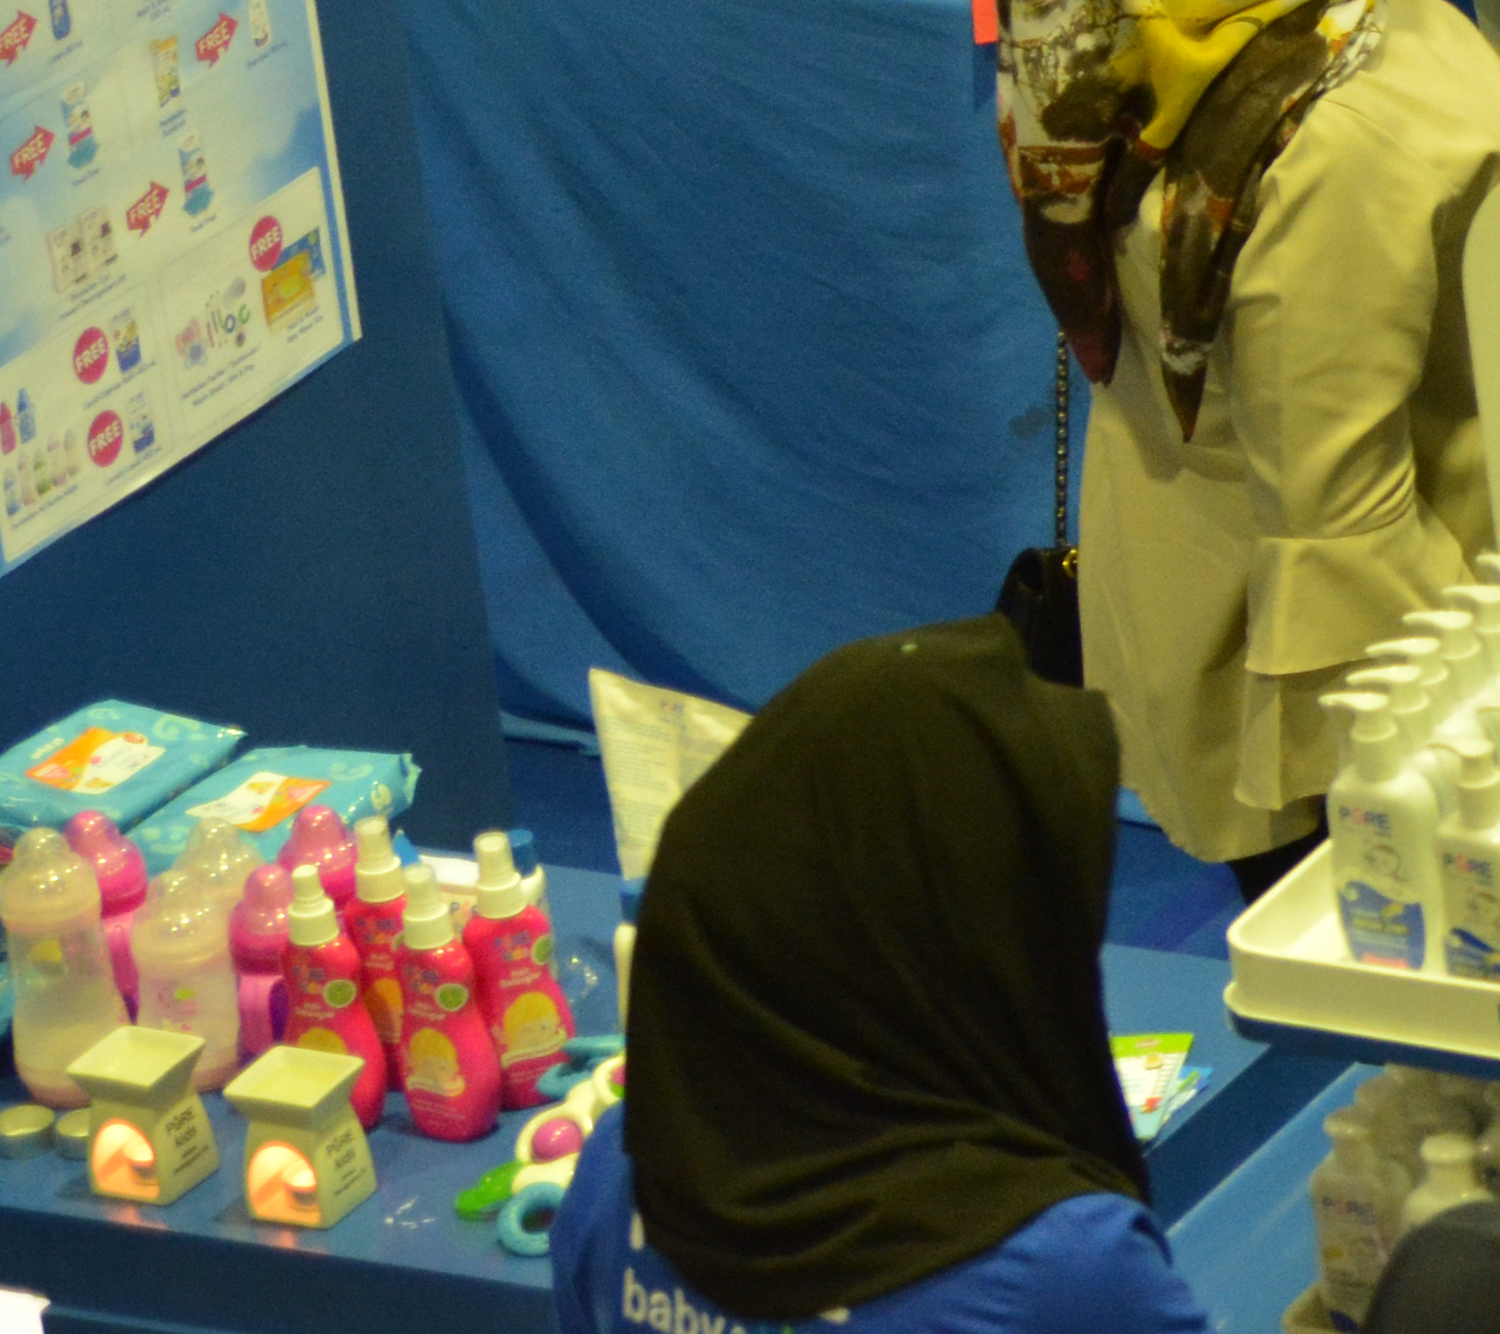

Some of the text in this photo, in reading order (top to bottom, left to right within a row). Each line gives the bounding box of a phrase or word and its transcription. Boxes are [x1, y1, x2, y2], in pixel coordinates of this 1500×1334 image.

[11, 139, 48, 172] FREE
[128, 197, 164, 231] FREE
[249, 227, 283, 259] FREE
[75, 341, 109, 373] FREE
[88, 421, 123, 453] FREE
